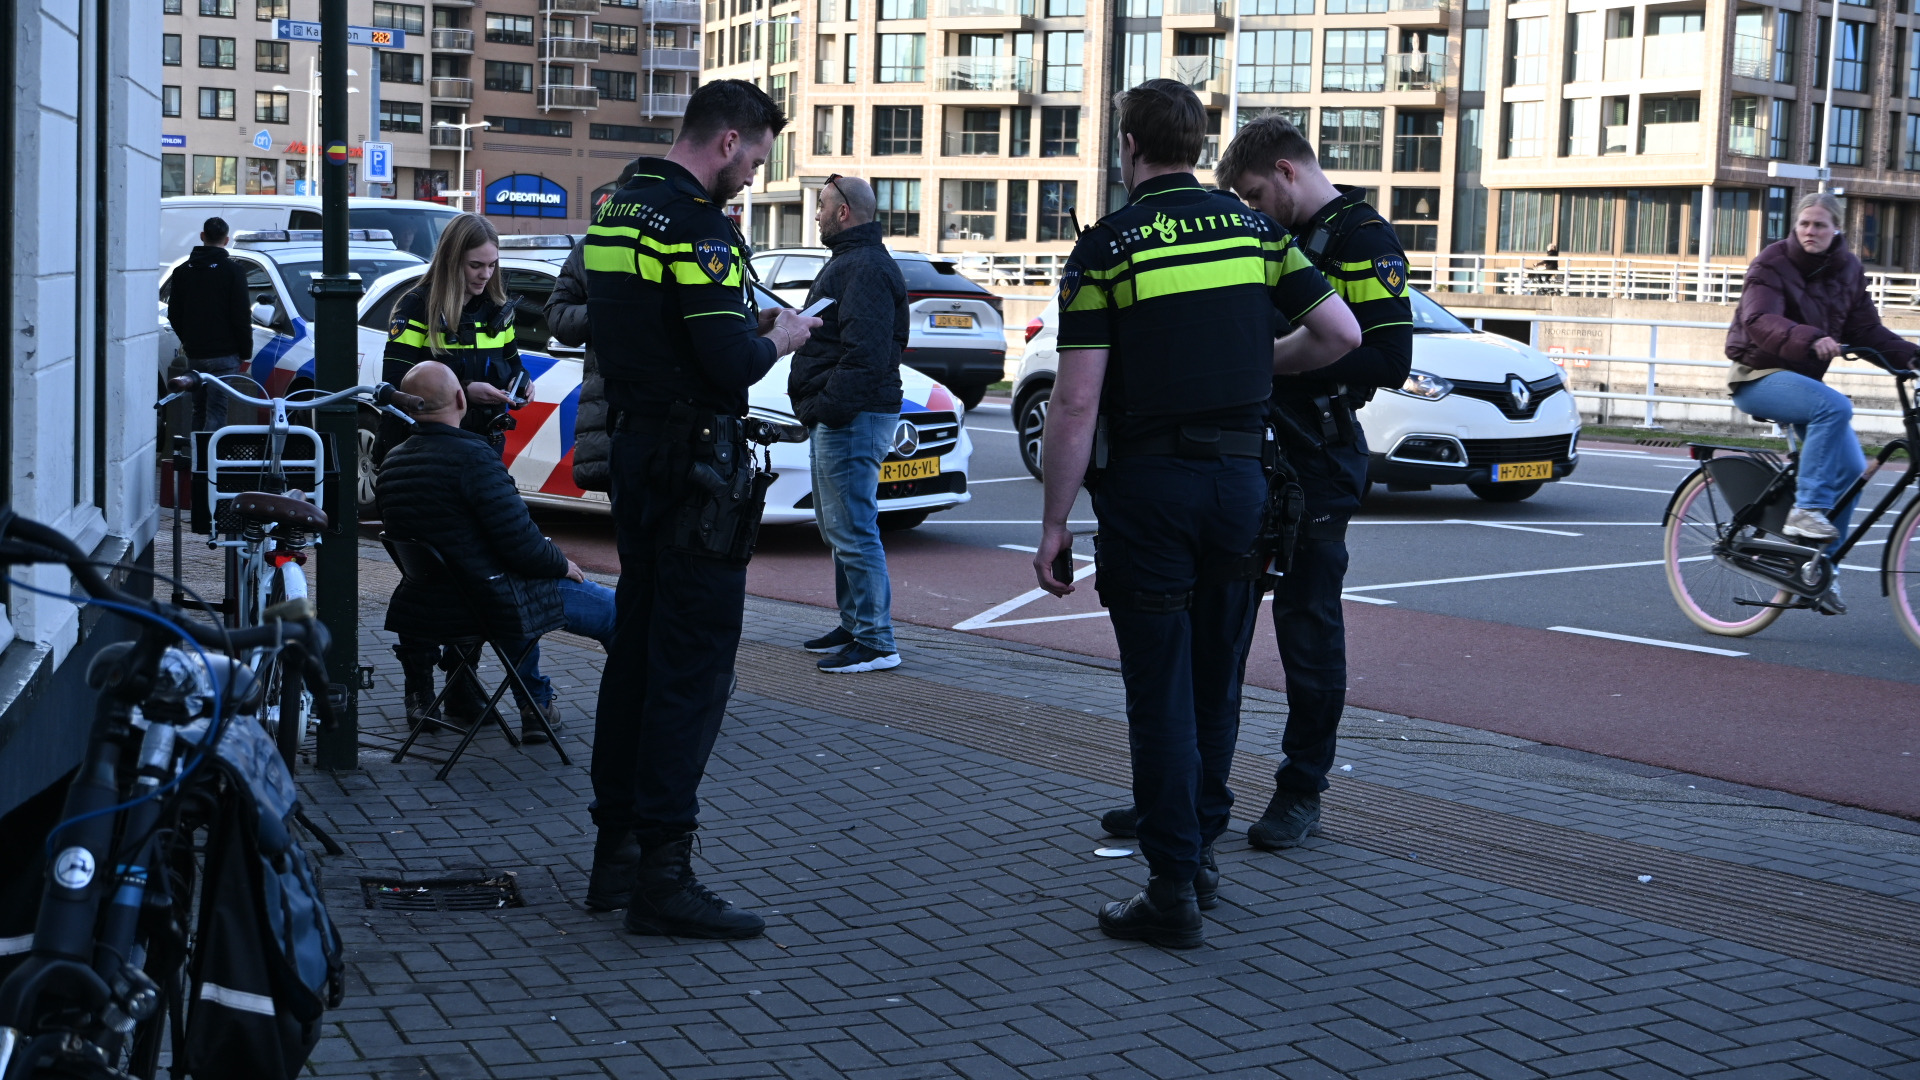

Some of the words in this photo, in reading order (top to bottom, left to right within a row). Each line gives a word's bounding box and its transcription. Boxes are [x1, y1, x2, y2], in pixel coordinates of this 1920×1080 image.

[373, 32, 390, 43] 282
[509, 192, 560, 204] DECATHLON
[1139, 212, 1242, 244] POLITIE
[698, 243, 728, 253] POLITIE
[1377, 260, 1403, 268] POLITIE
[884, 460, 935, 479] R-106-VL
[1500, 464, 1549, 479] H-702-XV
